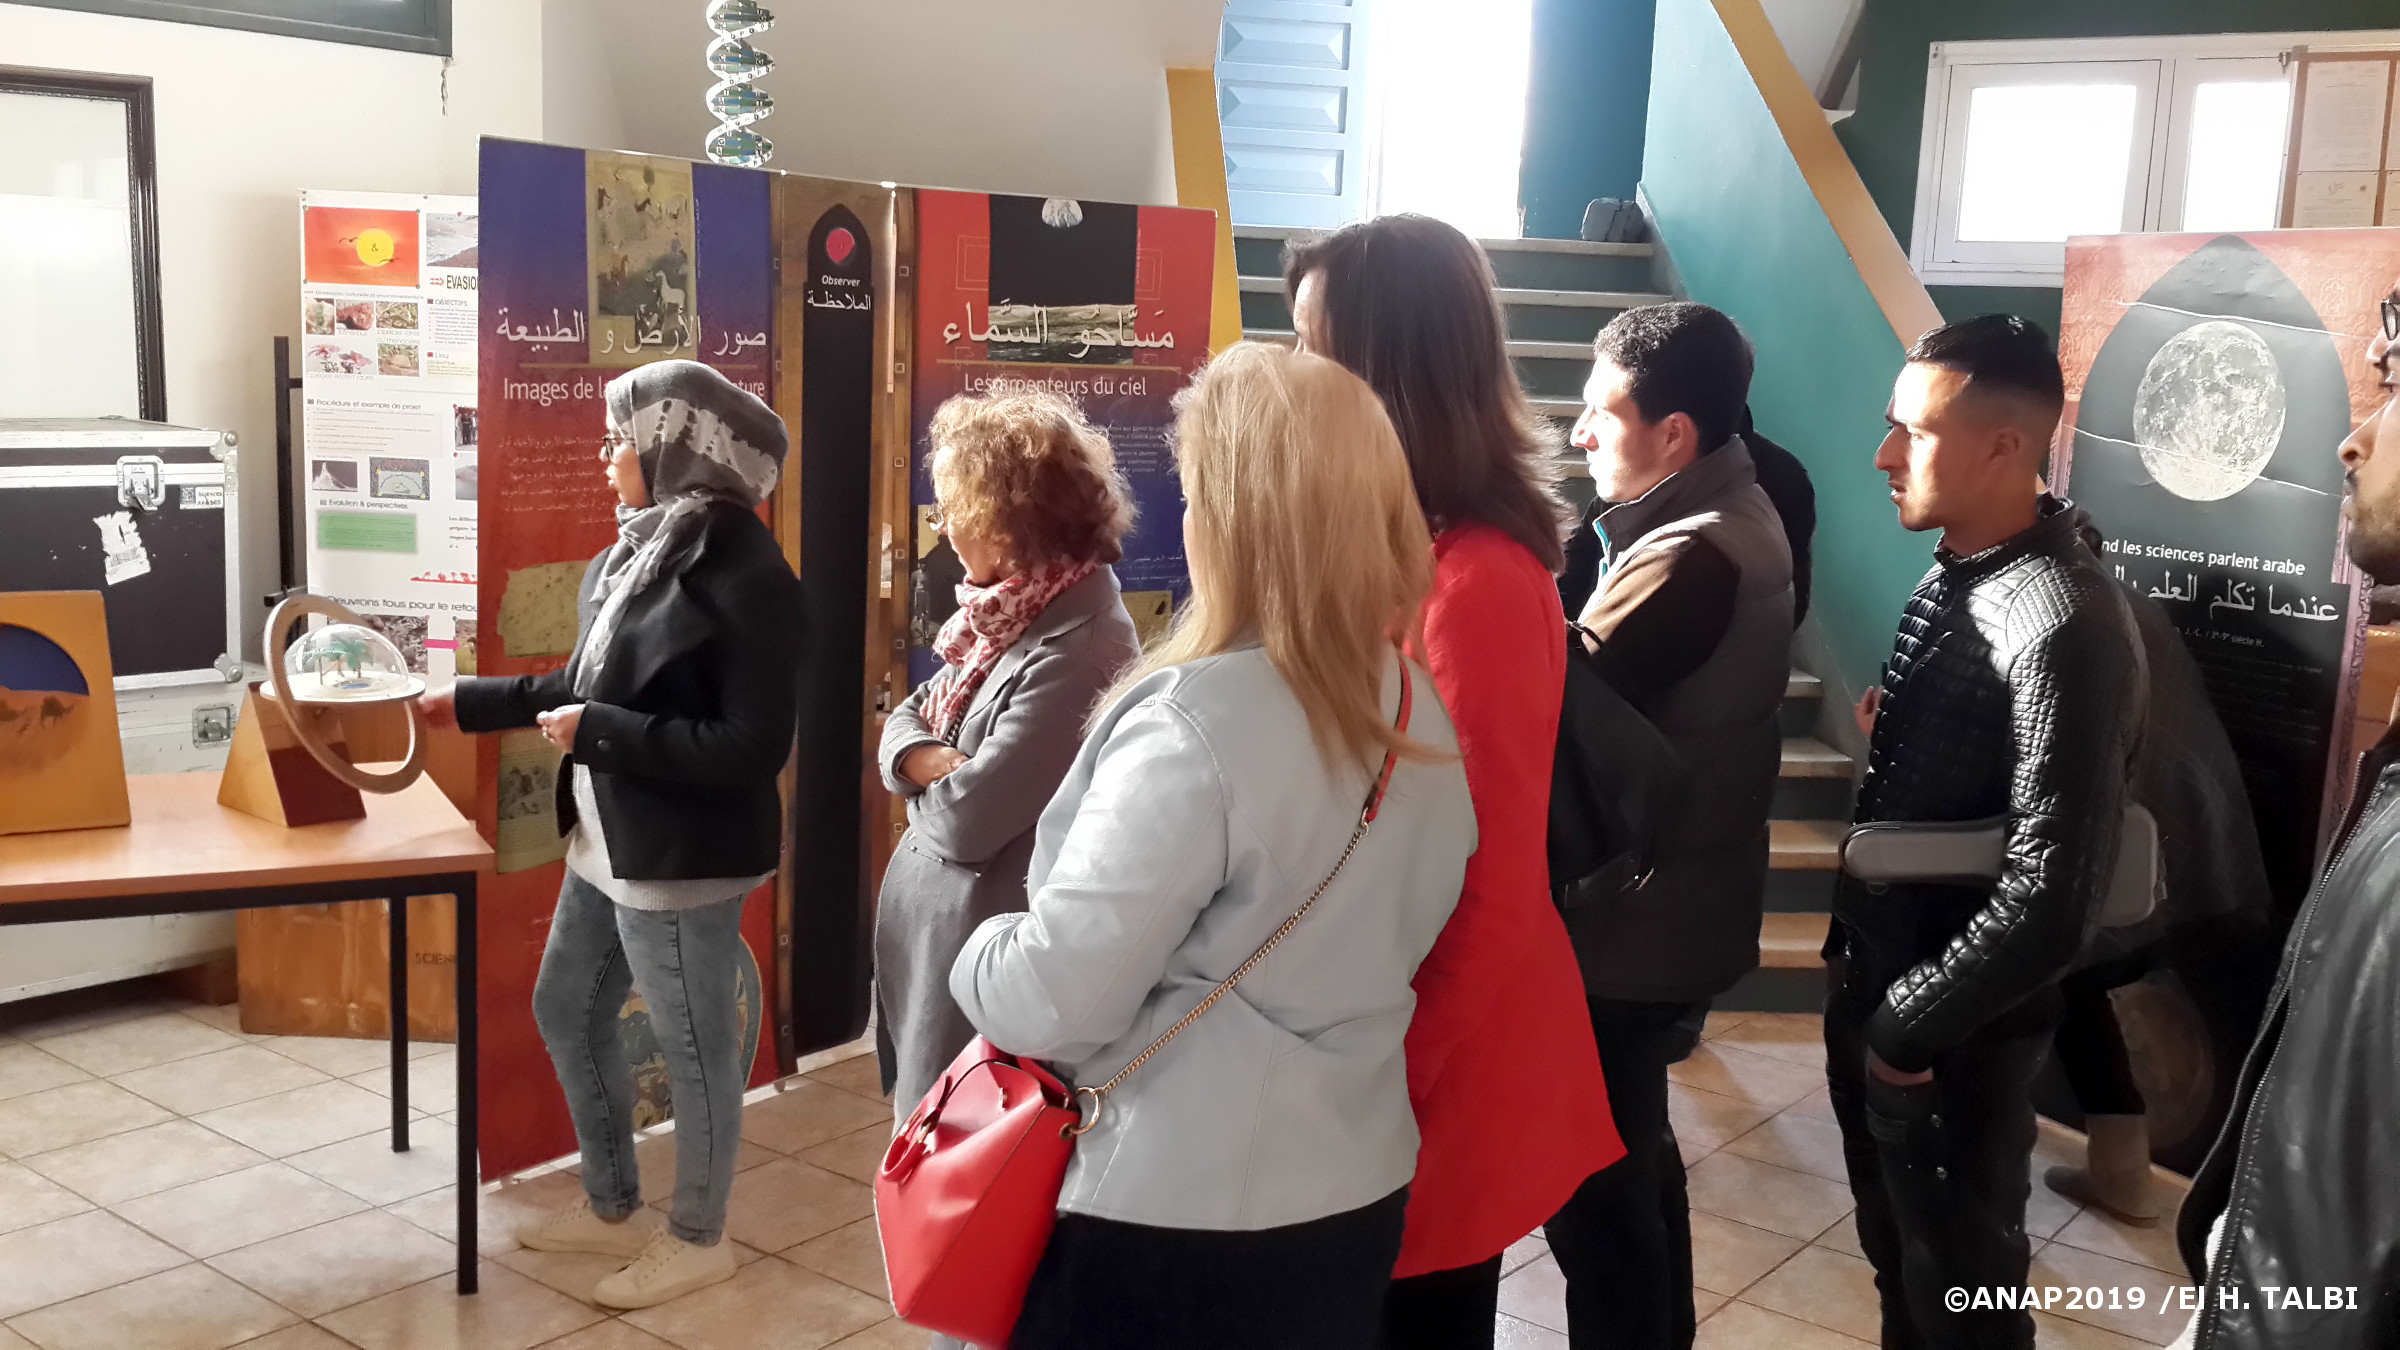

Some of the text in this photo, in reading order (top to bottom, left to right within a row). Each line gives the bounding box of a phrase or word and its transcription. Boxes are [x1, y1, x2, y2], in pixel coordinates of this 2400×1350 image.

[446, 275, 478, 290] EVASIO
[821, 275, 860, 287] Observer
[807, 289, 871, 311] الملاحظة
[496, 307, 585, 352] الطبيعة
[598, 329, 614, 354] و
[713, 329, 767, 356] صور
[504, 377, 568, 406] Images
[574, 378, 594, 399] de
[733, 379, 765, 397] ture
[965, 373, 992, 392] Les
[1094, 375, 1114, 395] du
[1119, 377, 1146, 396] ciel
[2122, 540, 2142, 555] les
[2145, 544, 2205, 563] sciences
[2207, 552, 2258, 570] parlent
[2262, 558, 2306, 576] arabe
[382, 599, 406, 609] tous
[409, 600, 435, 611] pour
[437, 602, 449, 611] le
[2209, 579, 2255, 620] تكلم
[2268, 584, 2340, 622] عندما
